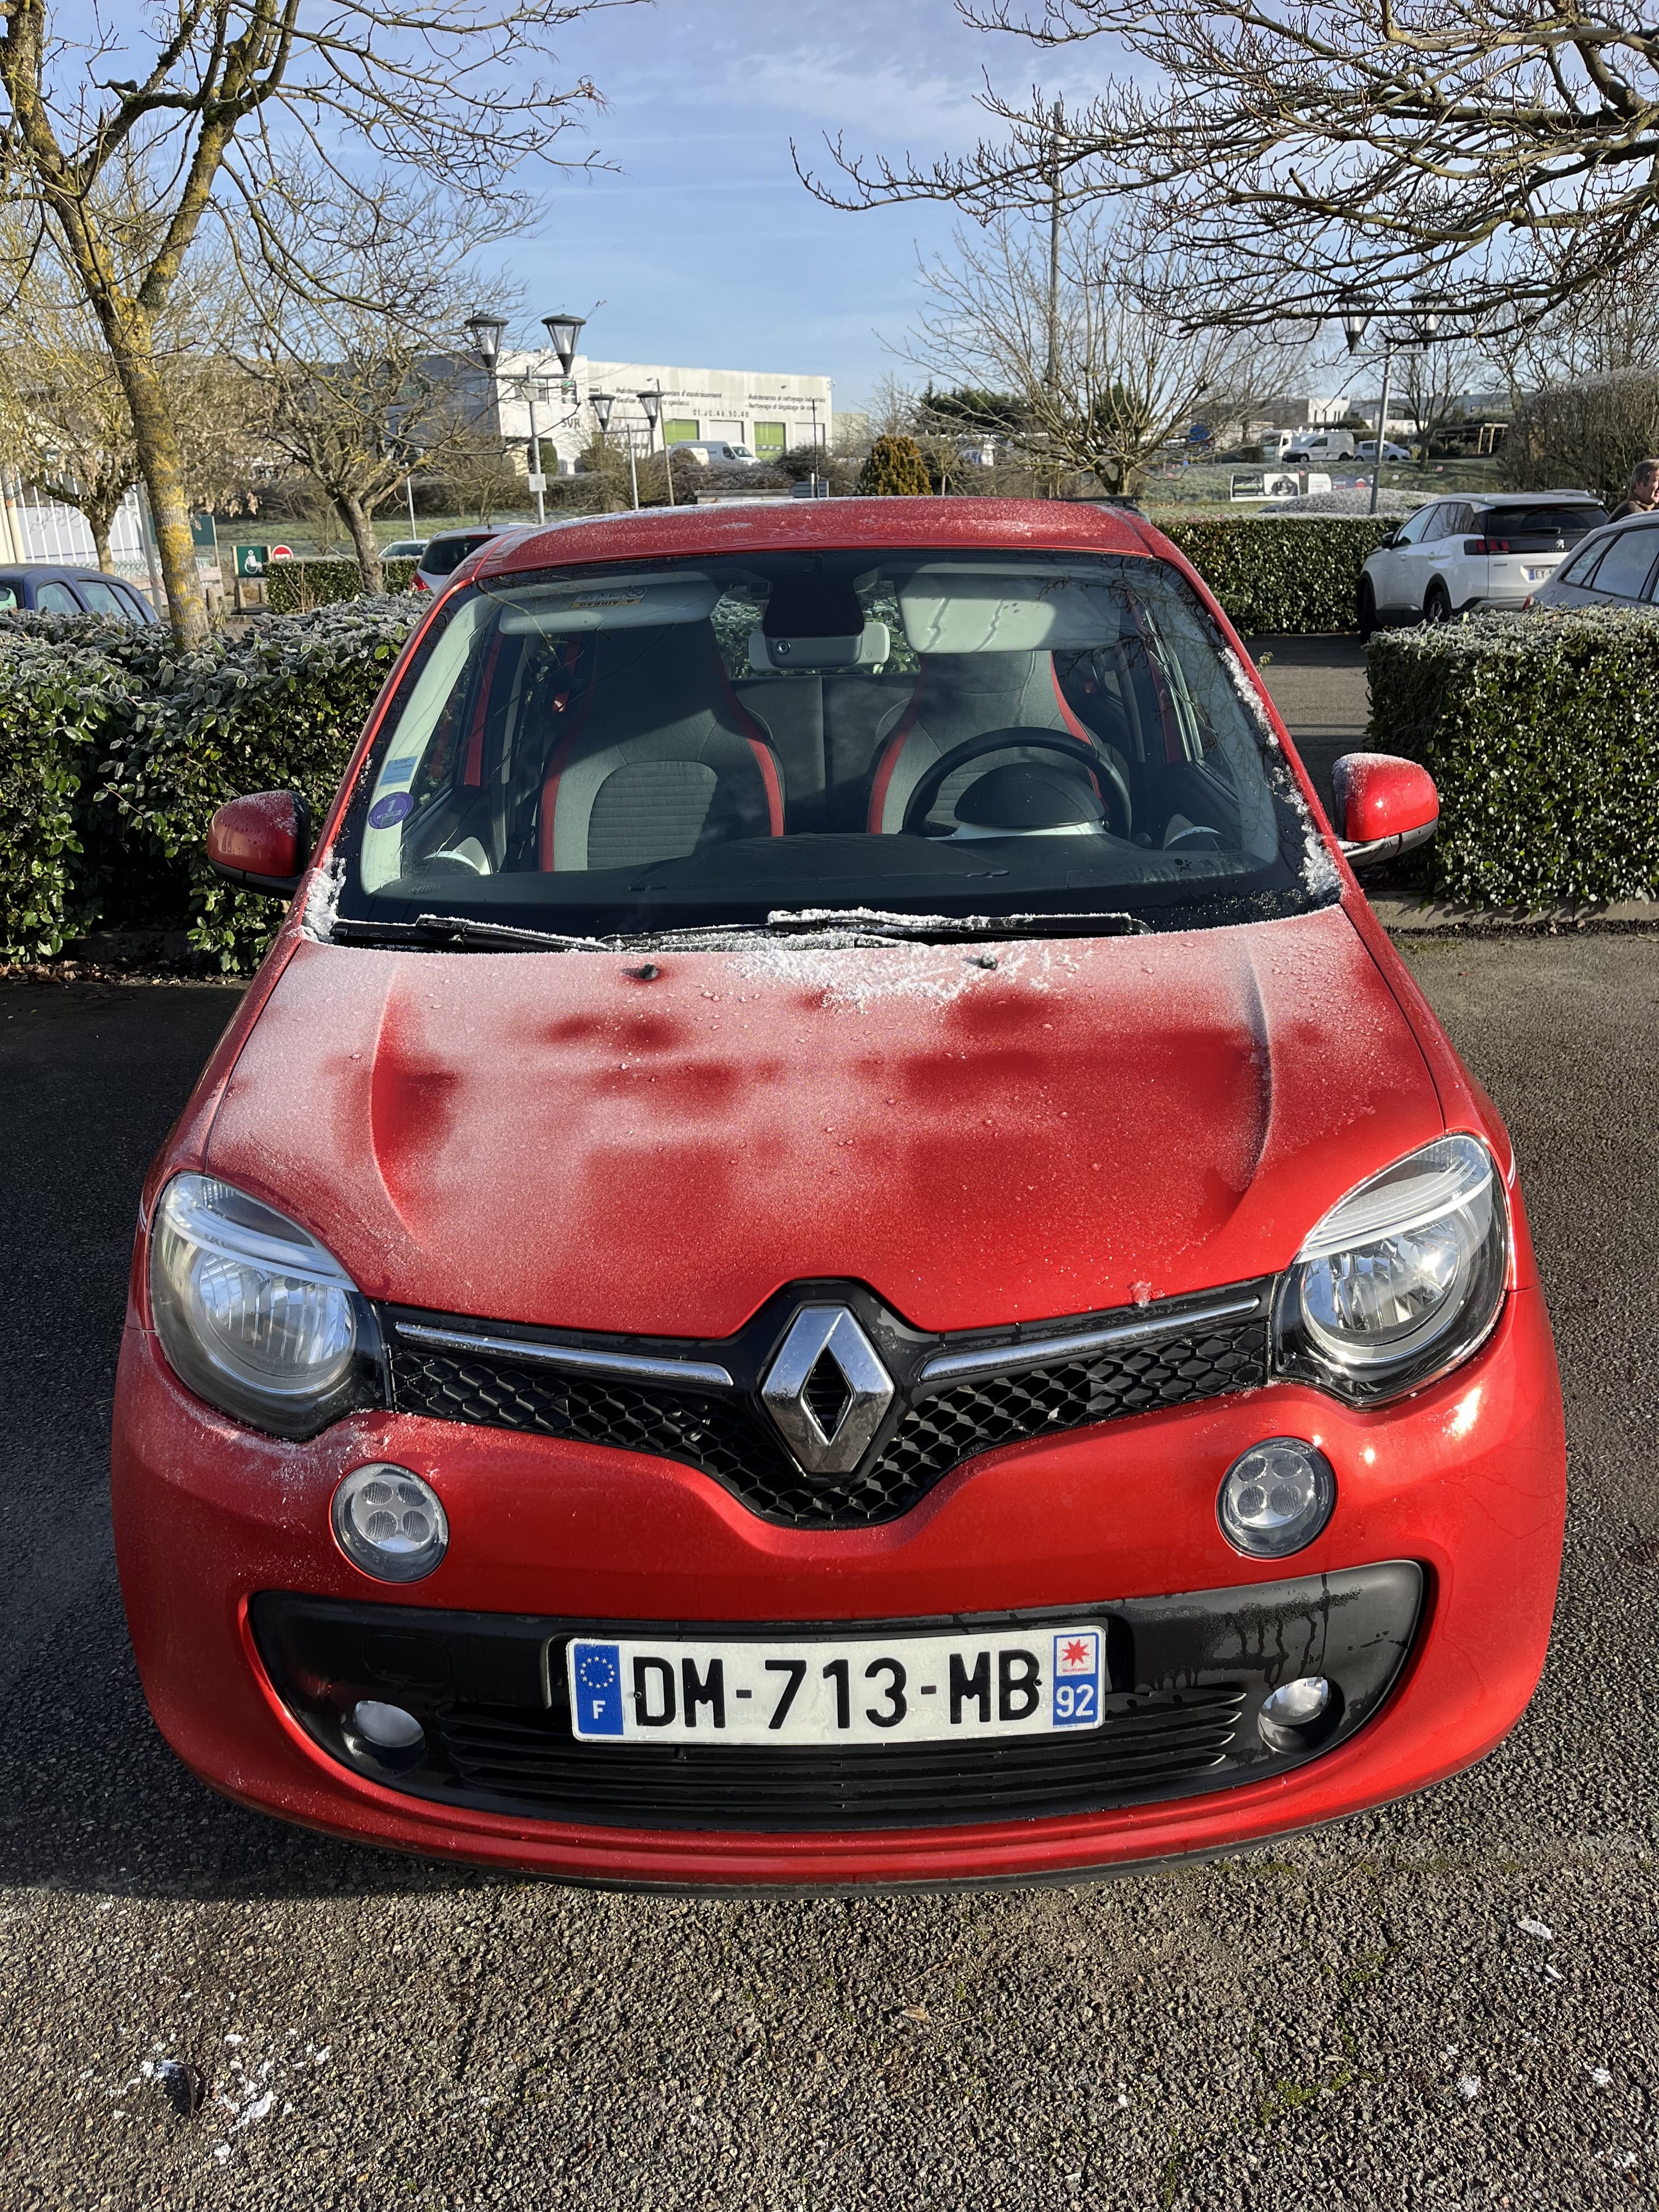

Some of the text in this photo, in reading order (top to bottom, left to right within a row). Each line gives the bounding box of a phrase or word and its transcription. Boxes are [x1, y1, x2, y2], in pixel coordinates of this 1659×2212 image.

[616, 387, 644, 395] Maintena
[561, 417, 580, 428] SVR
[387, 799, 396, 812] 1
[592, 1649, 1040, 1729] F DM-713-MB
[1056, 1684, 1094, 1717] 92
